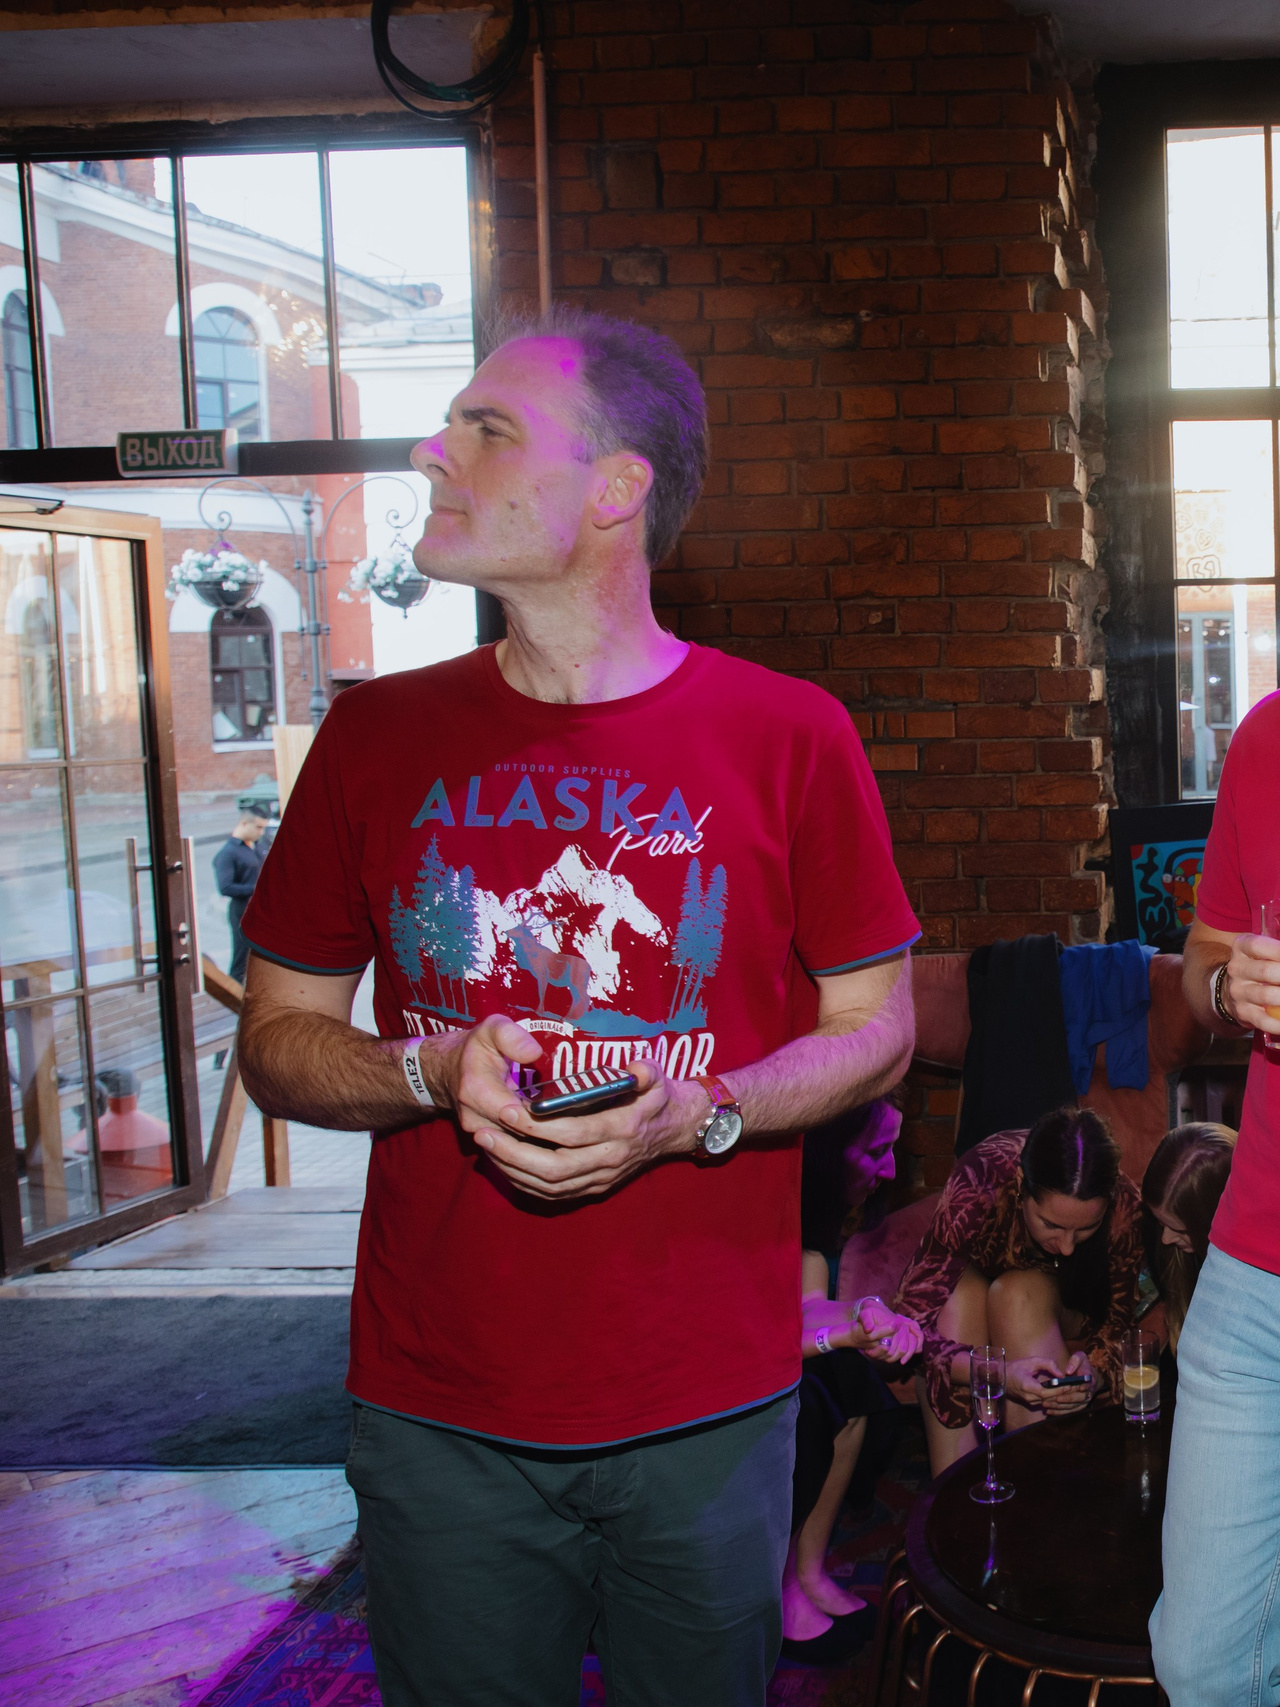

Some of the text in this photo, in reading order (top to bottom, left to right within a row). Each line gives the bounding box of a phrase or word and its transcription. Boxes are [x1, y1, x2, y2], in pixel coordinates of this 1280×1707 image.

[126, 435, 218, 467] ВЫХОД
[494, 763, 631, 778] OUTDOOR SUPPLIES
[410, 774, 699, 841] ALASKA
[606, 805, 713, 871] Park
[530, 1021, 564, 1032] ORIGINALS
[405, 1056, 425, 1094] TELE2
